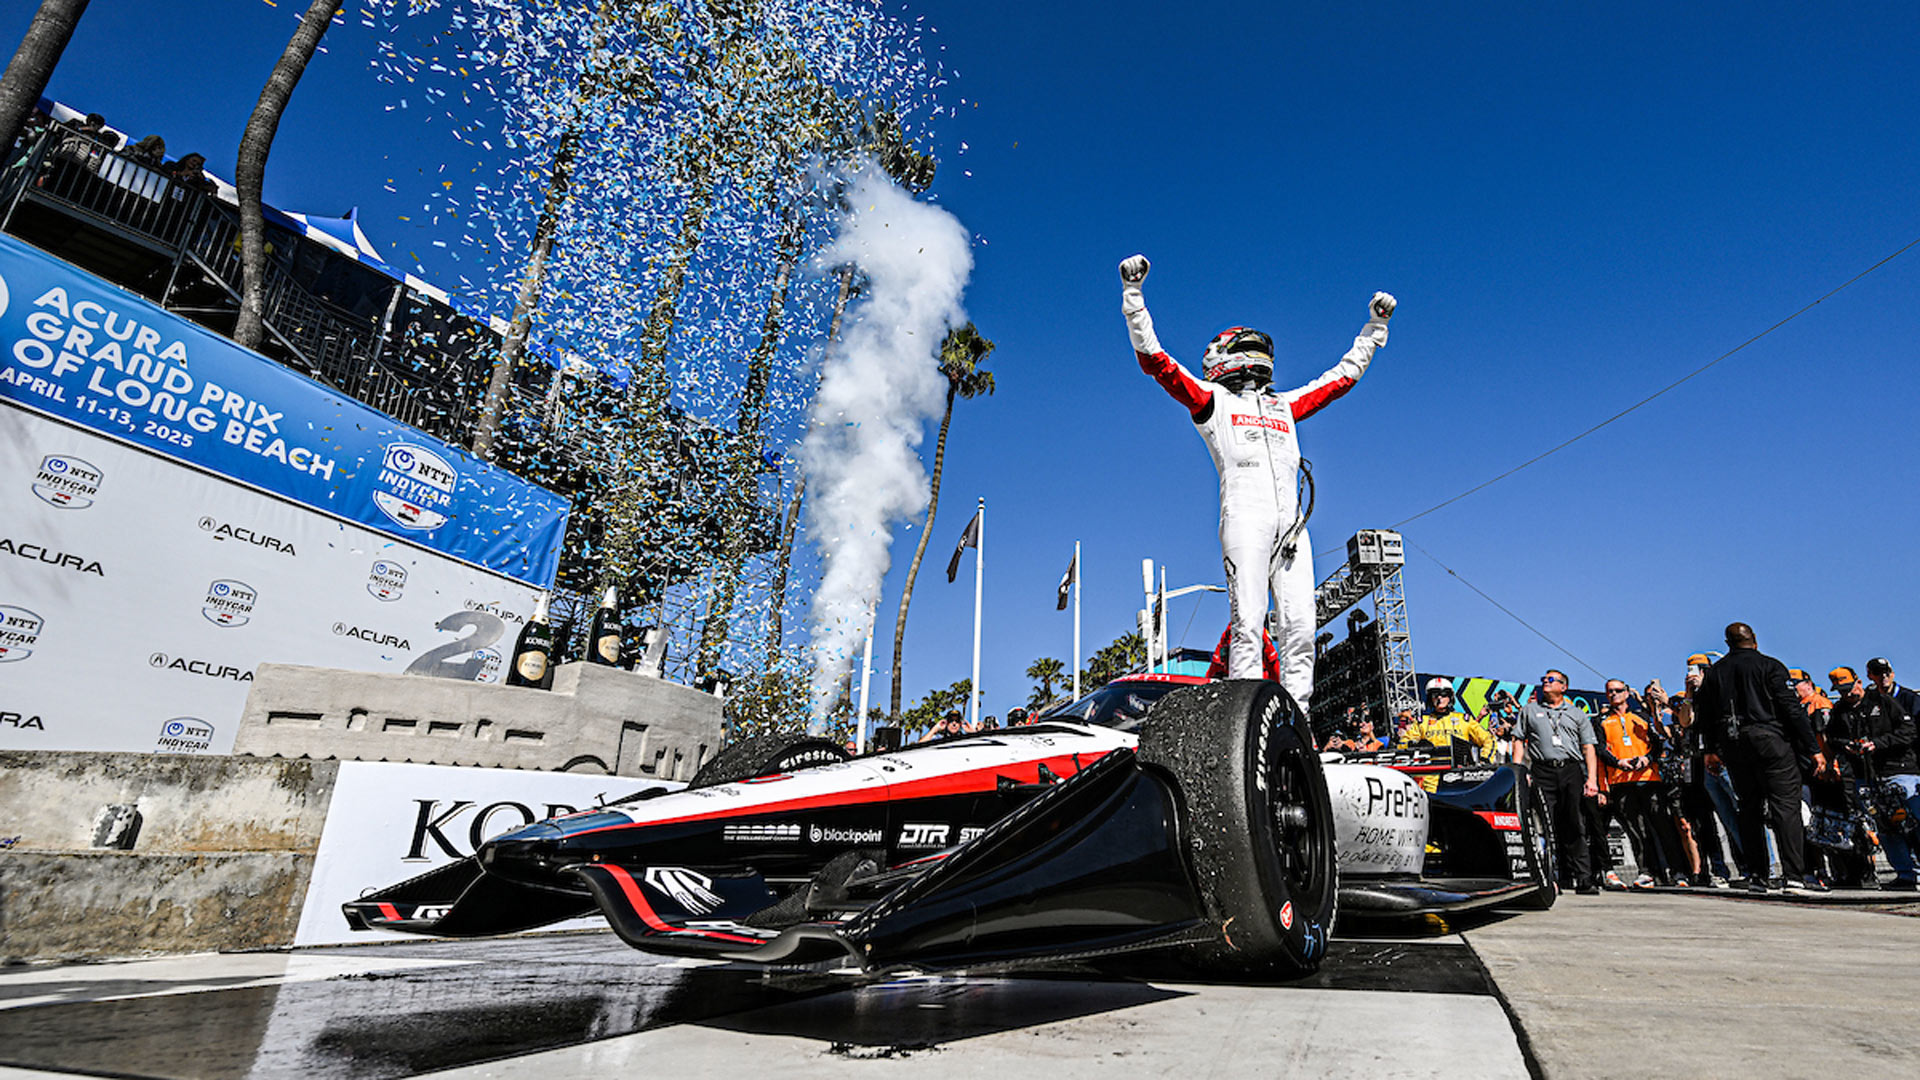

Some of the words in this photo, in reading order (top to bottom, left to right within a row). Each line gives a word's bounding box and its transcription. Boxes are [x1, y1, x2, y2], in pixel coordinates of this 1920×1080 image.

[33, 287, 188, 370] ACURA
[26, 312, 194, 394] GRAND
[200, 382, 283, 434] PRIX
[0, 367, 66, 403] APRIL
[76, 395, 136, 432] 11-13,
[143, 421, 194, 447] 2025
[13, 339, 86, 377] OF
[88, 366, 218, 433] LONG
[223, 419, 335, 481] BEACH
[37, 471, 98, 496] INDYCAR
[70, 467, 98, 482] NTT
[418, 462, 453, 485] NTT
[378, 469, 451, 507] INDYCAR
[216, 523, 296, 557] ACURA
[0, 538, 104, 577] ACURA
[205, 596, 252, 613] INDYCAR
[231, 590, 253, 601] NTT
[7, 616, 38, 631] NTT
[346, 626, 411, 652] ACURA
[403, 610, 505, 682] 2
[168, 657, 254, 683] ACURA
[157, 737, 210, 750] INDYCAR
[186, 727, 210, 738] NTT
[1256, 695, 1281, 792] Firestone
[779, 749, 844, 771] Firesto
[824, 827, 882, 844] blackpoint
[899, 824, 950, 844] DTR
[1355, 825, 1396, 846] HOME
